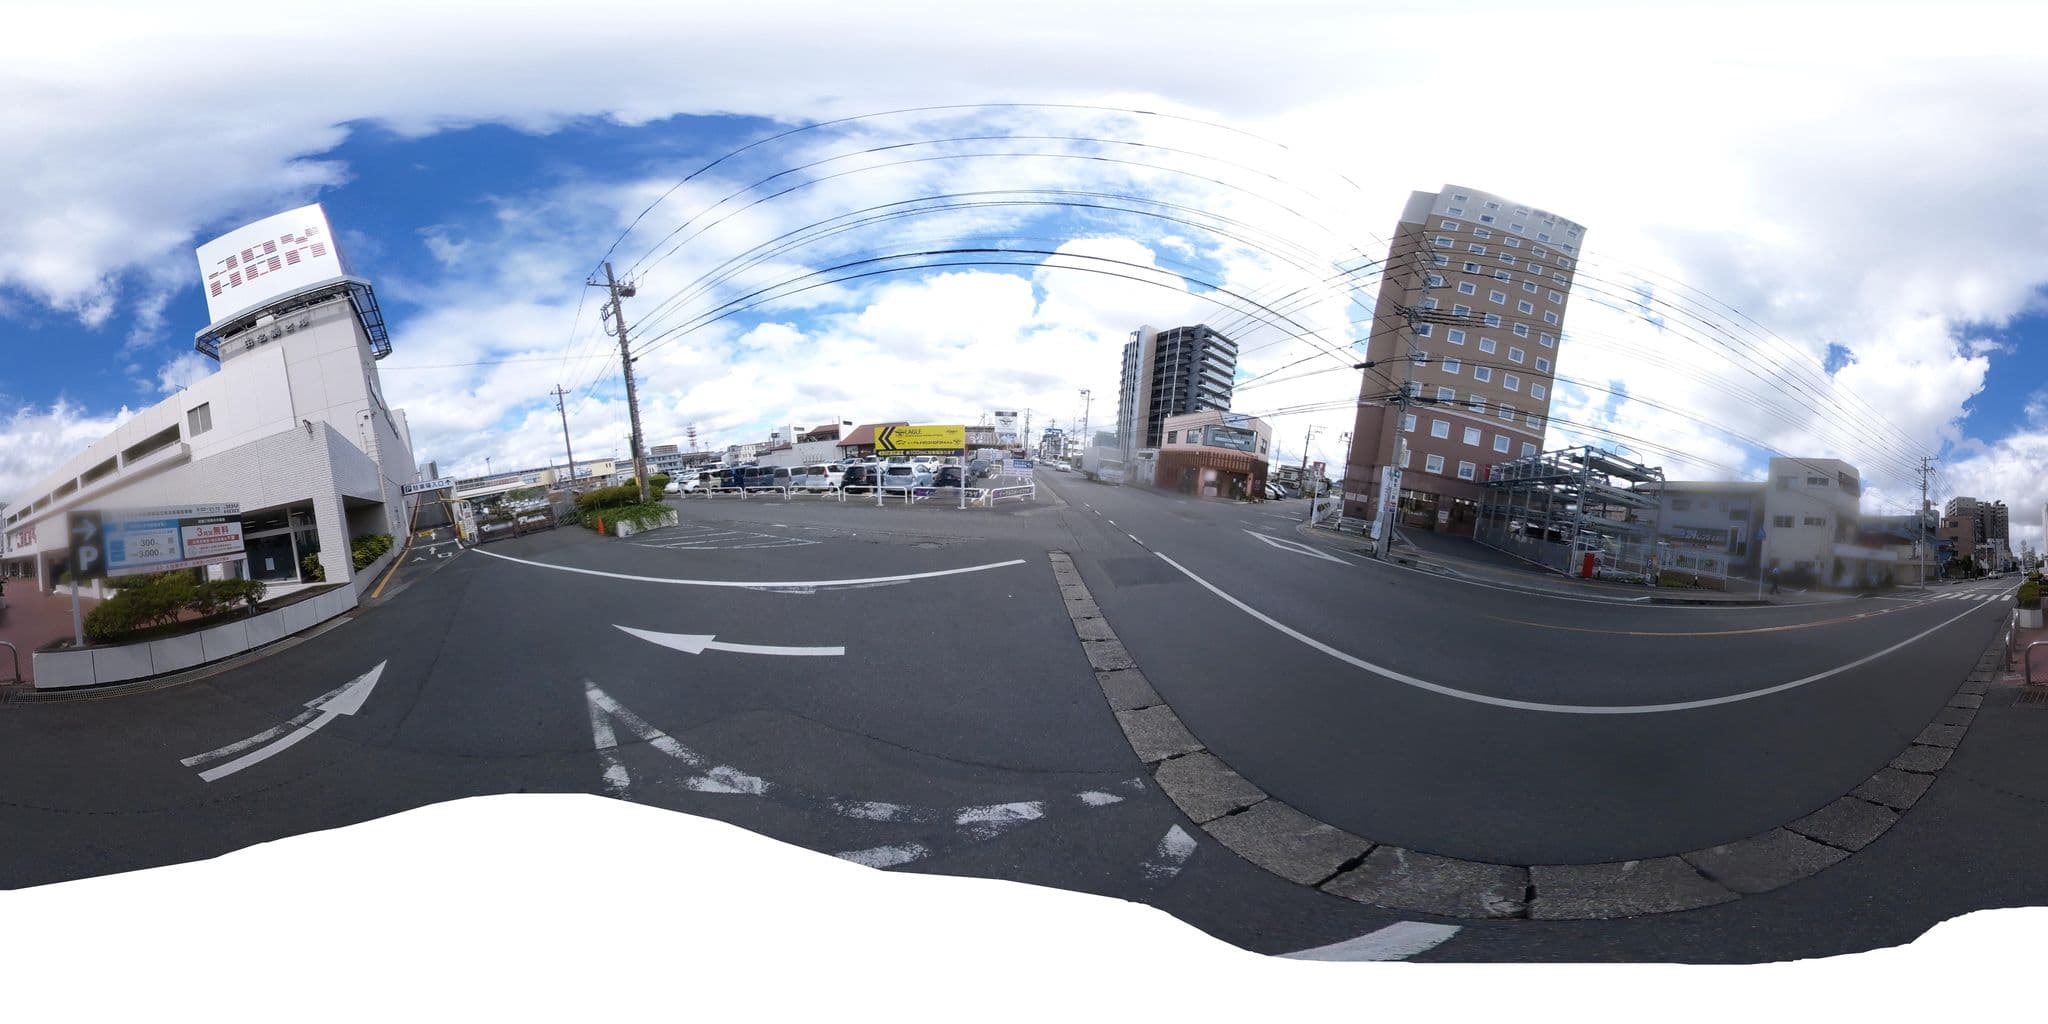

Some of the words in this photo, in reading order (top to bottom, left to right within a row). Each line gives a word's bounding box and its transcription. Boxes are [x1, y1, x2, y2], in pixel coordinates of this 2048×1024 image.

[413, 481, 444, 491] 駐車場入口
[140, 538, 155, 547] 300
[79, 546, 99, 571] P
